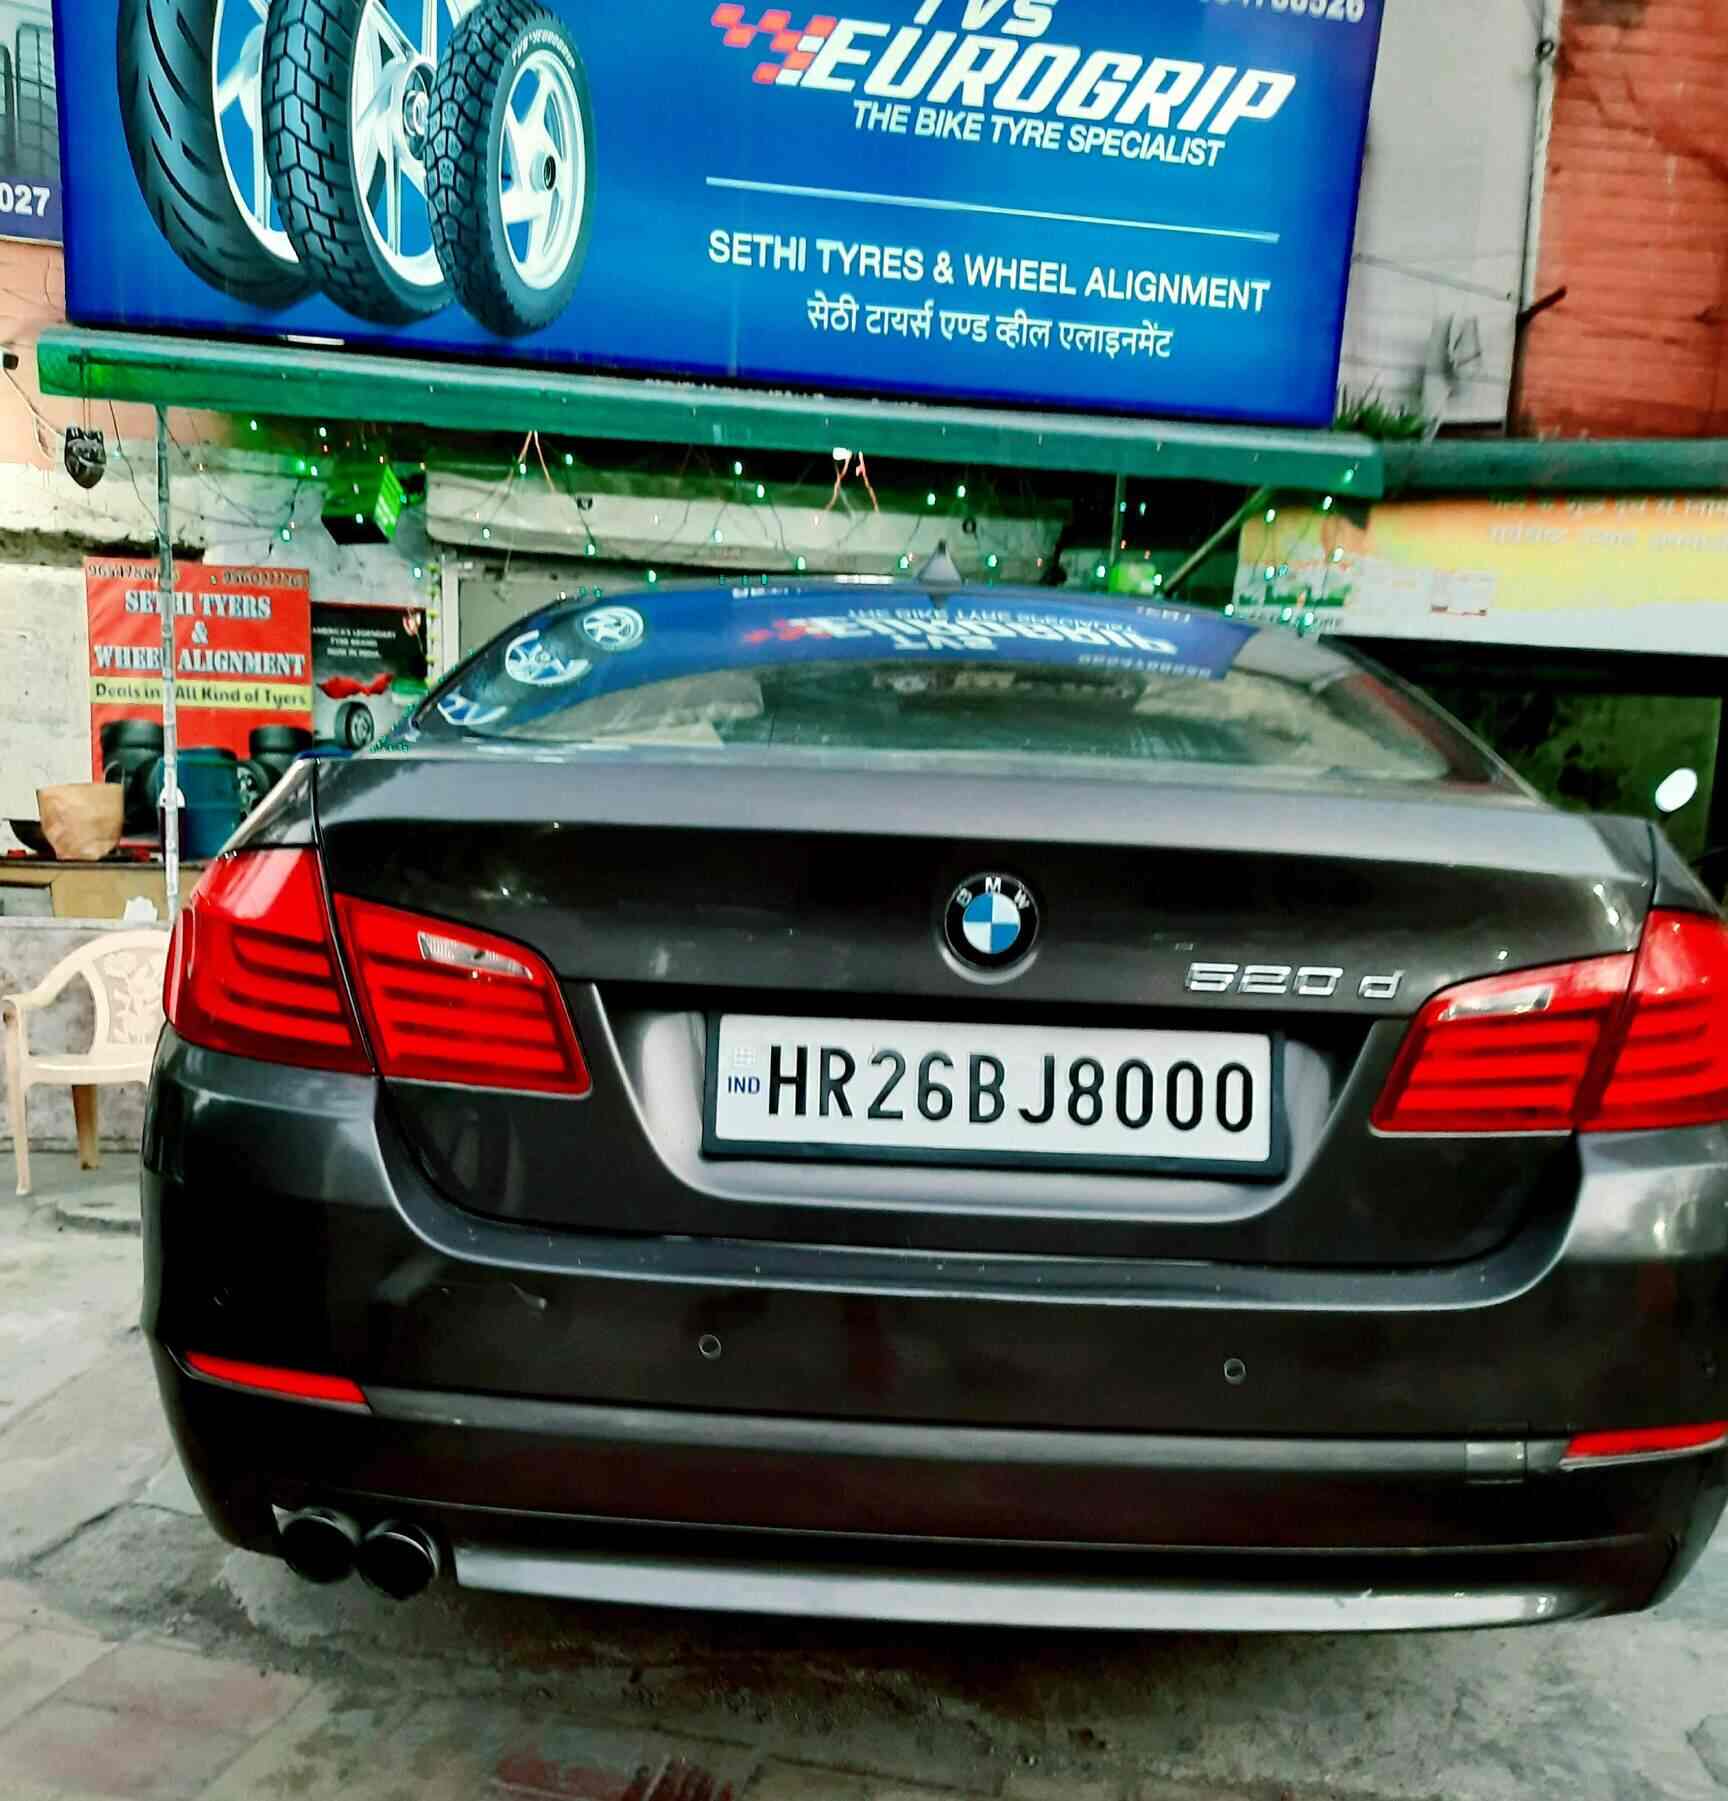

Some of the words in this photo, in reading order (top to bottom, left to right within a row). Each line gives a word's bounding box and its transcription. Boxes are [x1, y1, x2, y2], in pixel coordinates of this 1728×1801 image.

[798, 18, 1297, 134] EUROGRIP
[853, 101, 910, 134] THE
[915, 109, 980, 141] BIKE
[992, 119, 1061, 149] TYRE
[1067, 125, 1225, 168] SPECIALIST
[708, 230, 806, 272] SETHI
[815, 239, 924, 281] TYRES
[932, 251, 954, 285] &
[965, 253, 1077, 296] WHEEL
[1084, 270, 1271, 312] ALIGNMENT
[807, 289, 860, 333] सेठी
[865, 298, 935, 340] टायर्स
[938, 310, 990, 342] एण्ड
[995, 308, 1053, 349] व्हील
[1058, 319, 1174, 360] एलाइनमेंट
[201, 592, 272, 619] TYERS
[191, 620, 209, 645] &
[94, 645, 172, 670] WHEE
[177, 648, 305, 677] ALIGNMENT
[95, 682, 141, 697] Deals
[175, 685, 197, 700] All
[201, 687, 240, 702] Kind
[244, 687, 259, 703] of
[264, 689, 306, 708] Tyers
[956, 876, 1030, 910] BMW
[727, 1075, 760, 1095] IND
[768, 1045, 1254, 1133] HR26BJ8000
